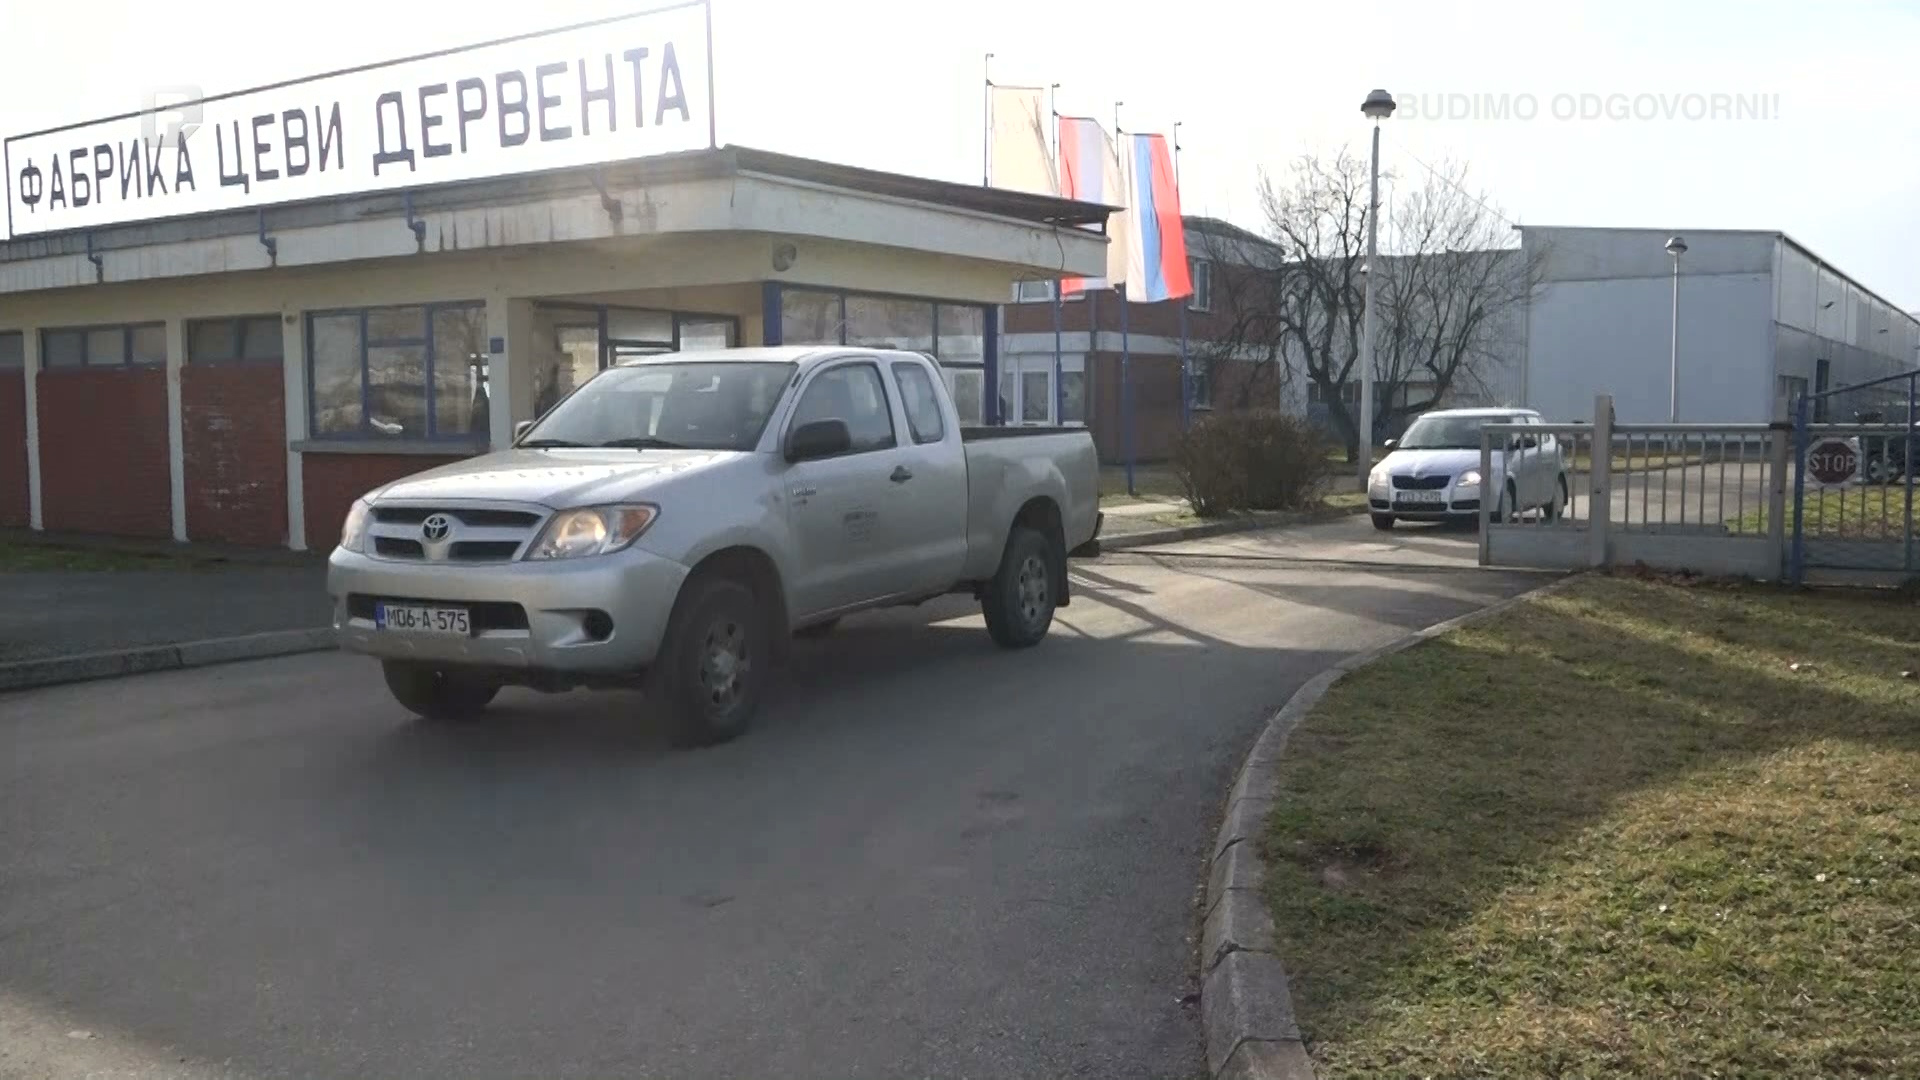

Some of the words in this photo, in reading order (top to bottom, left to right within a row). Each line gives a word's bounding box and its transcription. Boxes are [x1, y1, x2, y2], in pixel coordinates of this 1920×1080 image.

[19, 130, 196, 214] ФАБРИКА
[215, 101, 345, 195] ЦЕВИ
[372, 42, 691, 176] ДЕРВЕНТА
[1810, 453, 1856, 472] STOP
